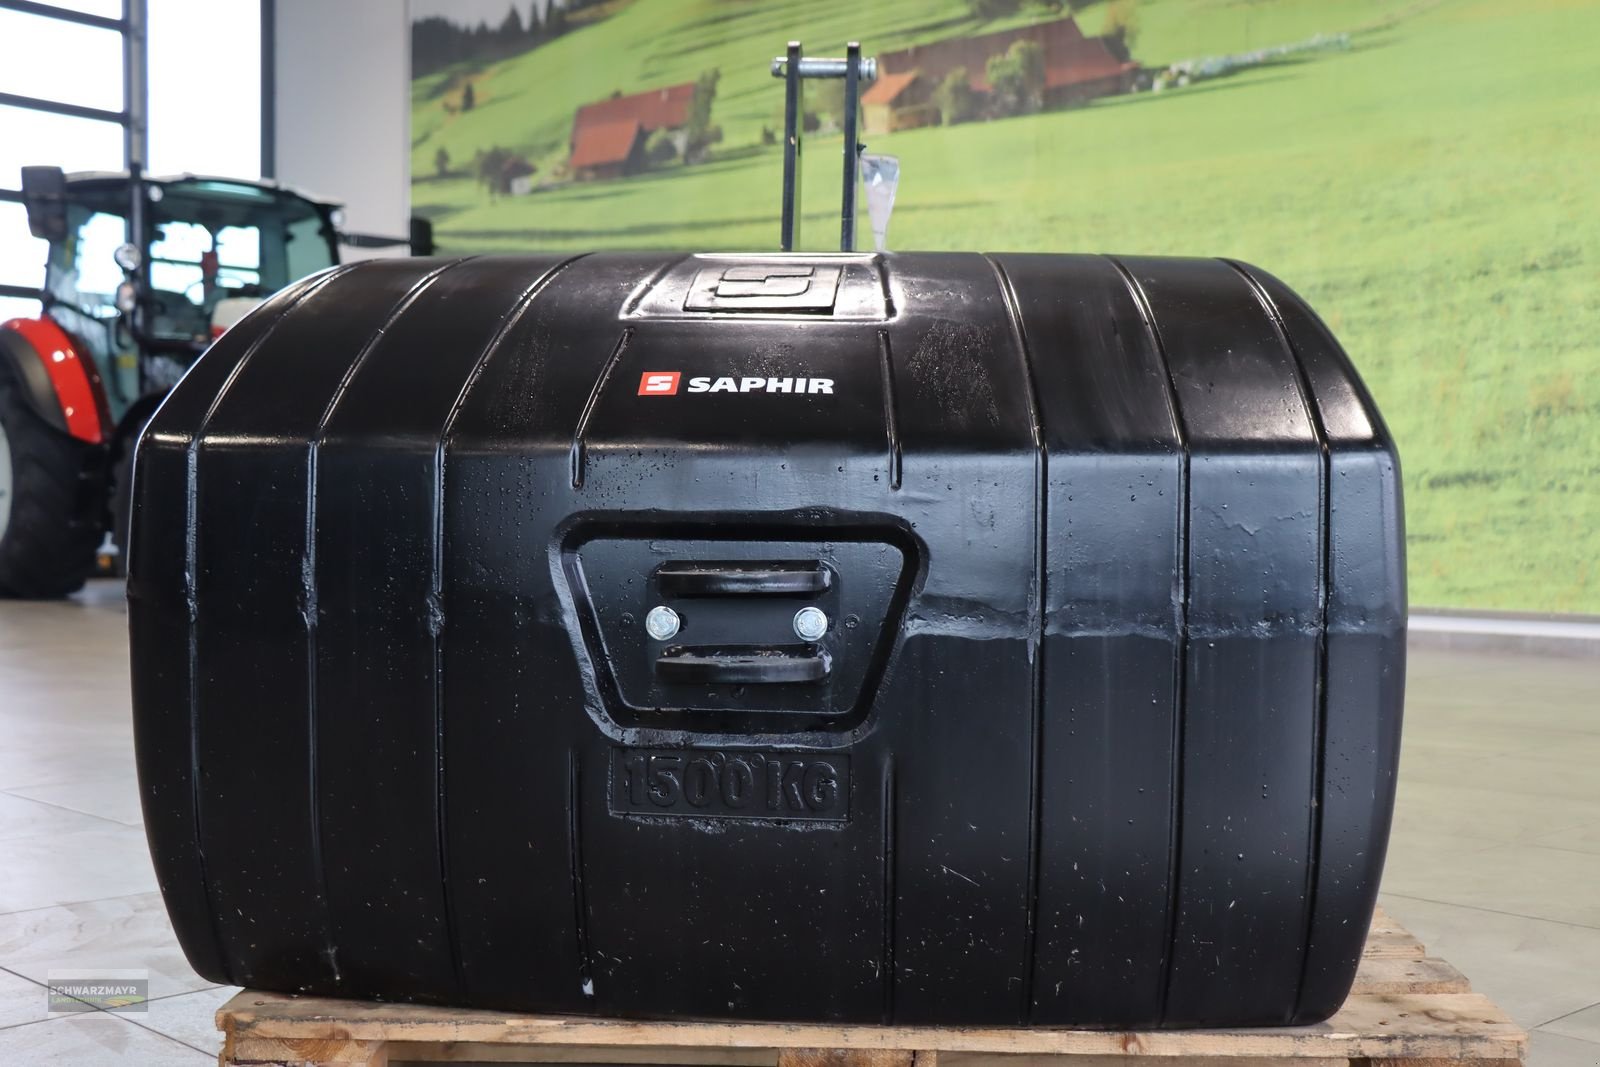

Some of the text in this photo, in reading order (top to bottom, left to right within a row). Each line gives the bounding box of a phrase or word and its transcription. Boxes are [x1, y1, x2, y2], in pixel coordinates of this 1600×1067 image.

[687, 377, 835, 395] SAPHIR
[624, 756, 838, 812] 1500 KG
